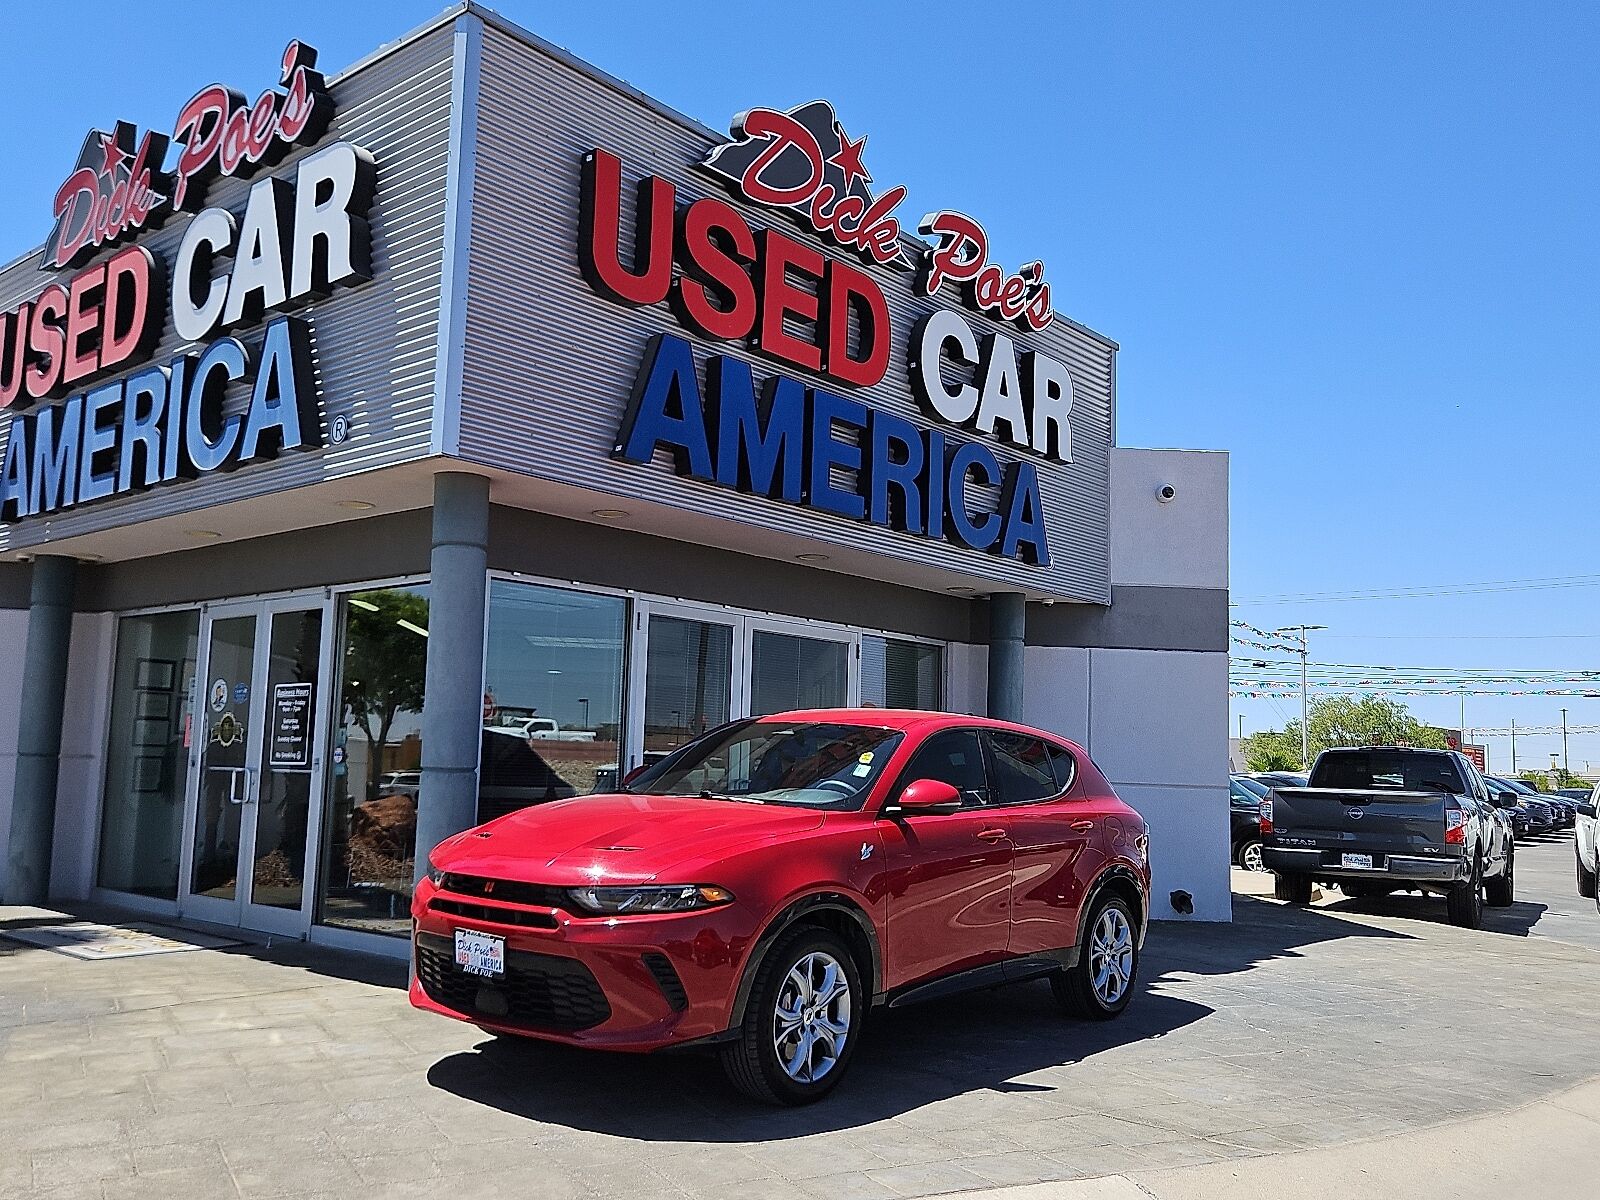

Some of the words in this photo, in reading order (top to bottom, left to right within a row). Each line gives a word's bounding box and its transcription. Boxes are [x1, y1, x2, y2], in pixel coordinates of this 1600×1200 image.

[54, 129, 156, 267] Dick
[173, 38, 316, 211] Poe's
[740, 106, 908, 265] Dick
[928, 211, 1055, 332] Poe's
[0, 245, 151, 408] USED
[172, 142, 357, 340] CAR
[591, 147, 892, 389] USED
[919, 309, 1076, 464] CAR
[0, 315, 303, 518] AMERICA
[621, 333, 1050, 567] AMERICA
[1276, 837, 1317, 846] TITAN
[463, 965, 479, 974] DICK
[479, 968, 493, 977] POE
